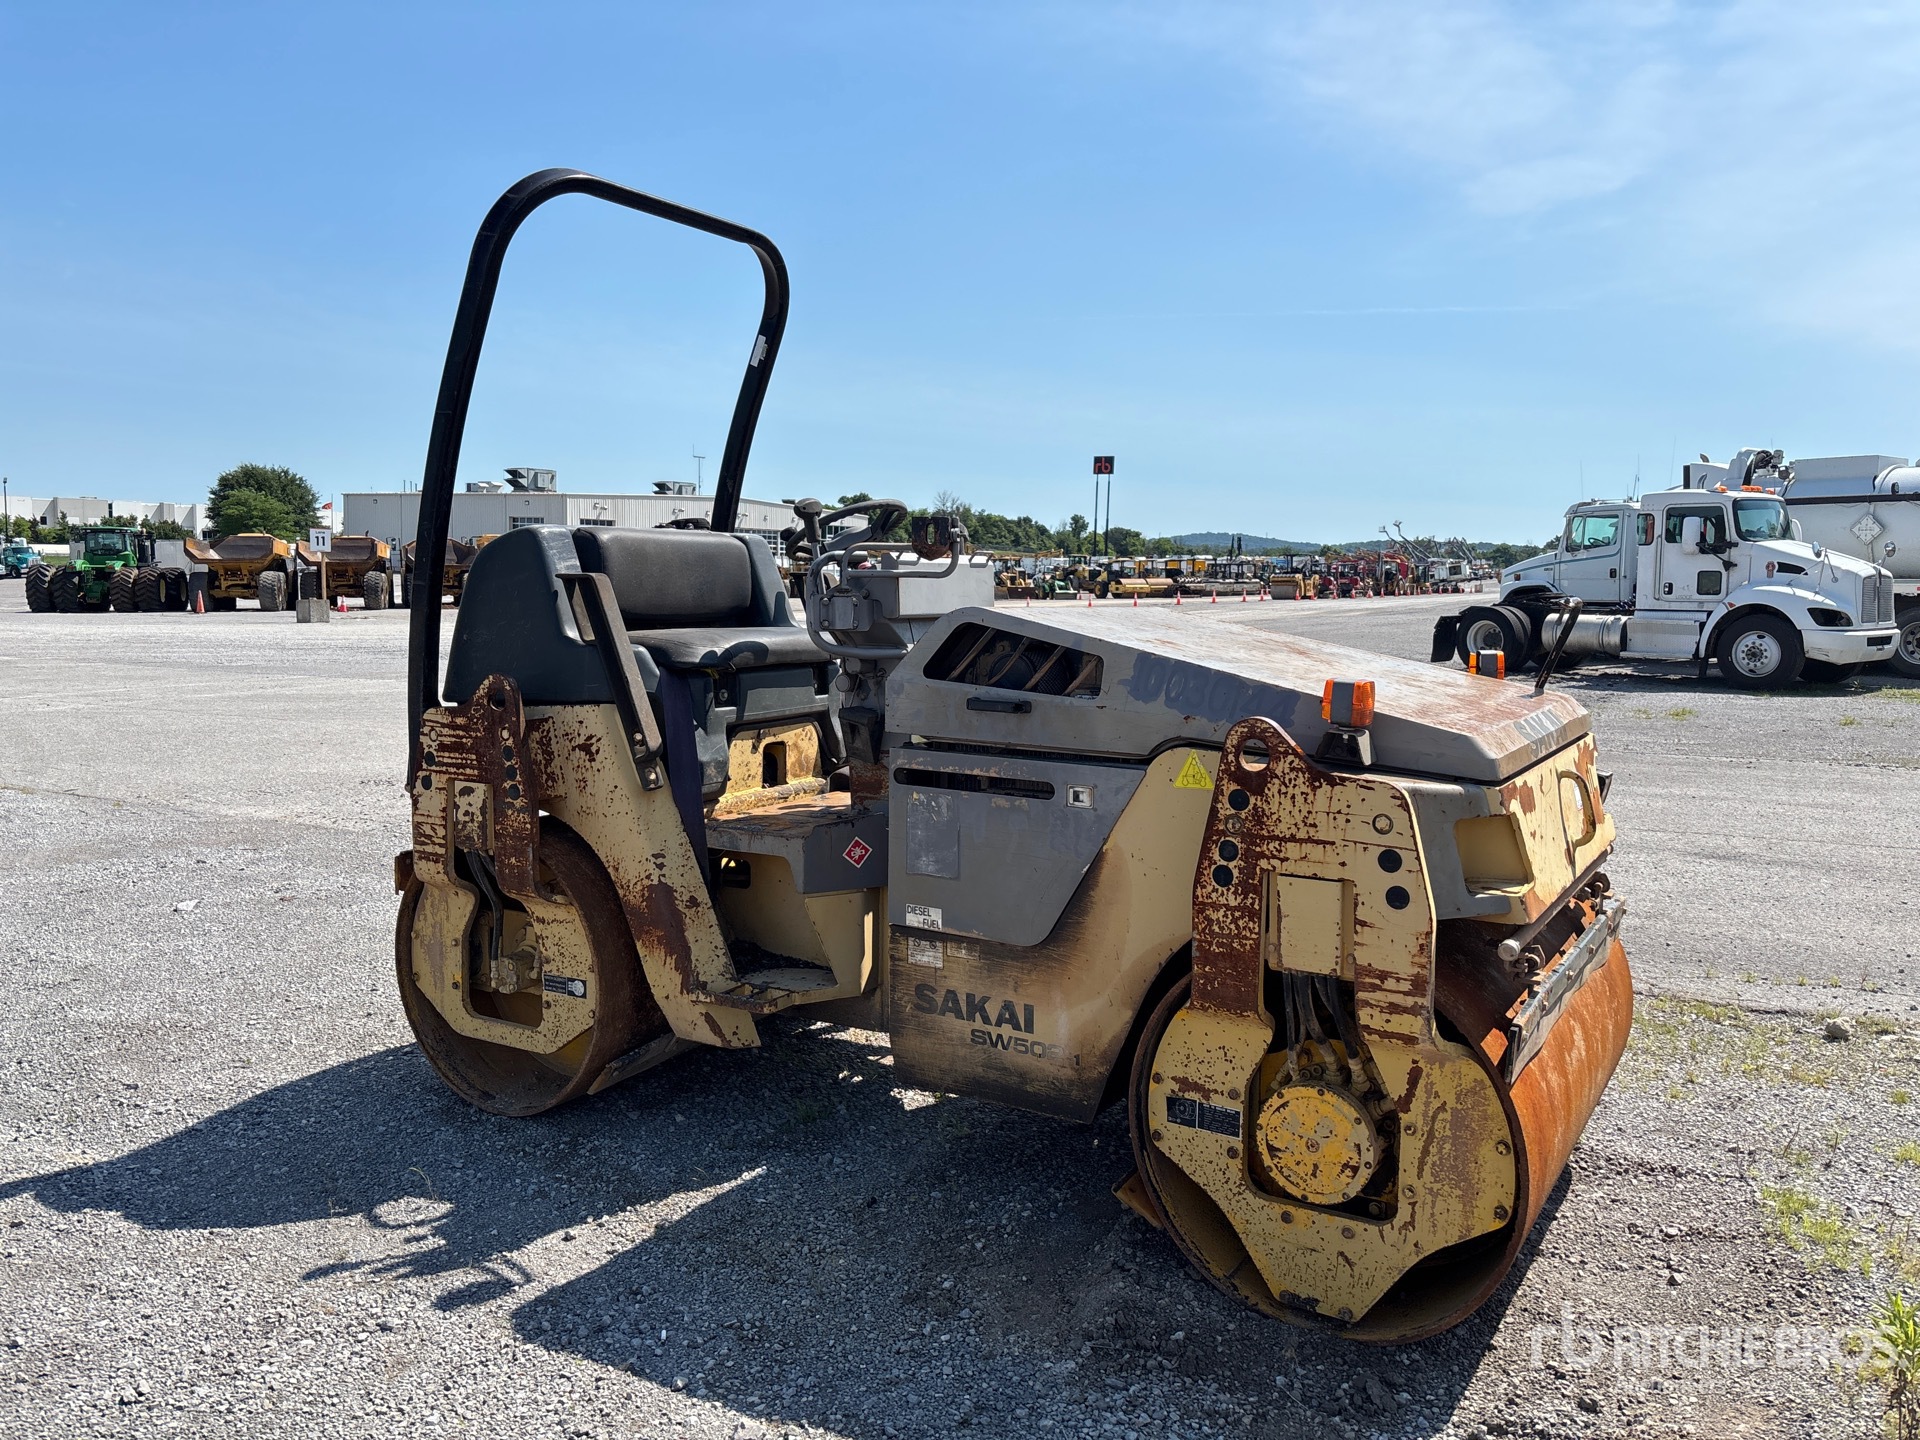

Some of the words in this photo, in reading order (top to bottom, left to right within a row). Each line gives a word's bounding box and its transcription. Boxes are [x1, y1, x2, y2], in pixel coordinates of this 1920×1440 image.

[1095, 456, 1111, 474] rb
[315, 536, 326, 546] 11
[906, 904, 932, 917] DIESEL
[922, 918, 941, 930] FUEL
[913, 983, 1035, 1034] SAKAI
